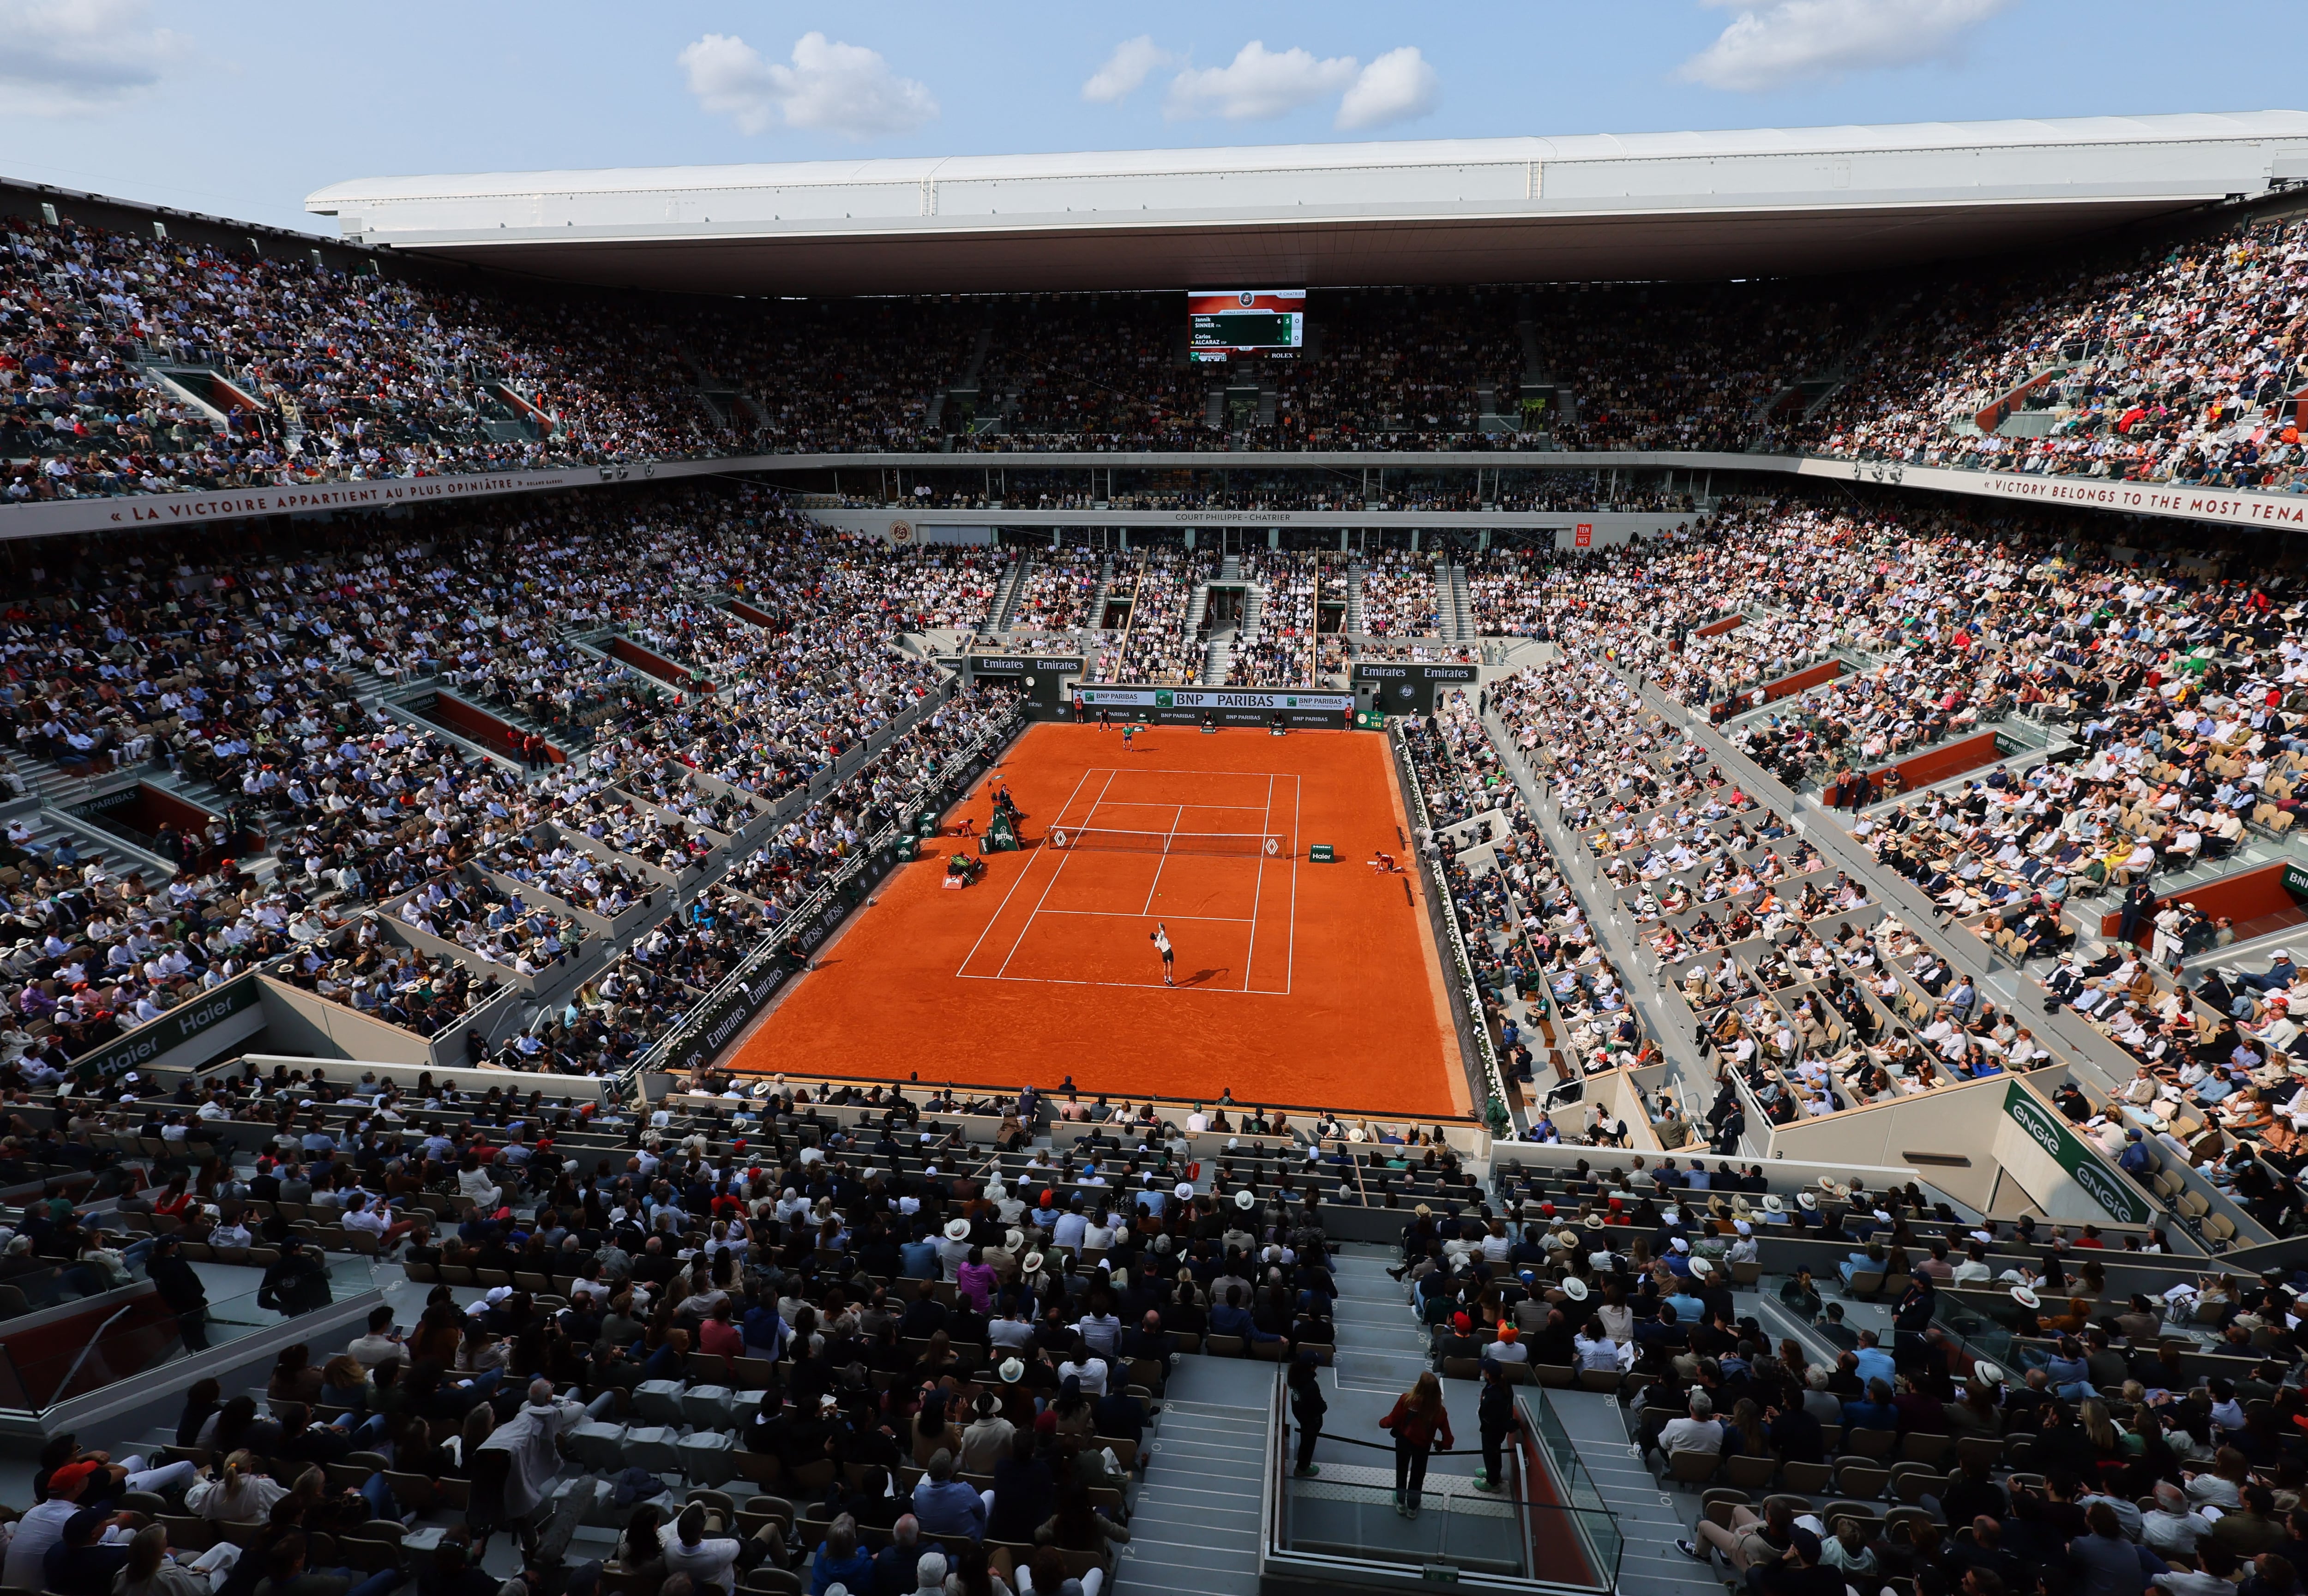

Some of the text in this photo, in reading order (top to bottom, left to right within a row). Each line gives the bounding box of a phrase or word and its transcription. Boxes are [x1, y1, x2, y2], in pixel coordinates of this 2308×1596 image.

[132, 507, 160, 521] LA
[168, 498, 267, 516] VICTOIRE
[277, 490, 377, 507] APPARTIENT
[386, 487, 403, 498] AU
[410, 485, 441, 496] PLUS
[448, 478, 512, 493] OPINIÂTRE
[1995, 480, 2047, 495] VICTORY
[2052, 486, 2115, 503] BELONGS
[2124, 492, 2141, 505] TO
[2151, 494, 2182, 509] THE
[2190, 498, 2241, 515] MOST
[2252, 504, 2304, 522] TENA
[983, 659, 1024, 669] Emirates
[1037, 660, 1078, 670] Emirates
[1362, 666, 1469, 678] Emirates Emirates
[409, 696, 435, 709] PARIBAS
[1177, 694, 1274, 707] BNP PARIBAS
[1996, 736, 2009, 746] BNP
[90, 791, 136, 811] PARIBAS
[994, 832, 1013, 846] Perrier
[822, 902, 844, 926] Infosys
[800, 923, 823, 950] Infosys
[747, 966, 783, 1006] Emirates
[178, 997, 233, 1035] Haier
[706, 1005, 746, 1049] Emirates
[96, 1037, 158, 1077] Haier
[1461, 1026, 1475, 1071] Emirates
[1472, 1074, 1487, 1122] Emirates
[1776, 1151, 1783, 1159] 3
[1170, 1352, 1180, 1365] 08
[1604, 1393, 1616, 1407] 08
[1659, 1491, 1672, 1506] 10
[1121, 1546, 1136, 1560] 12
